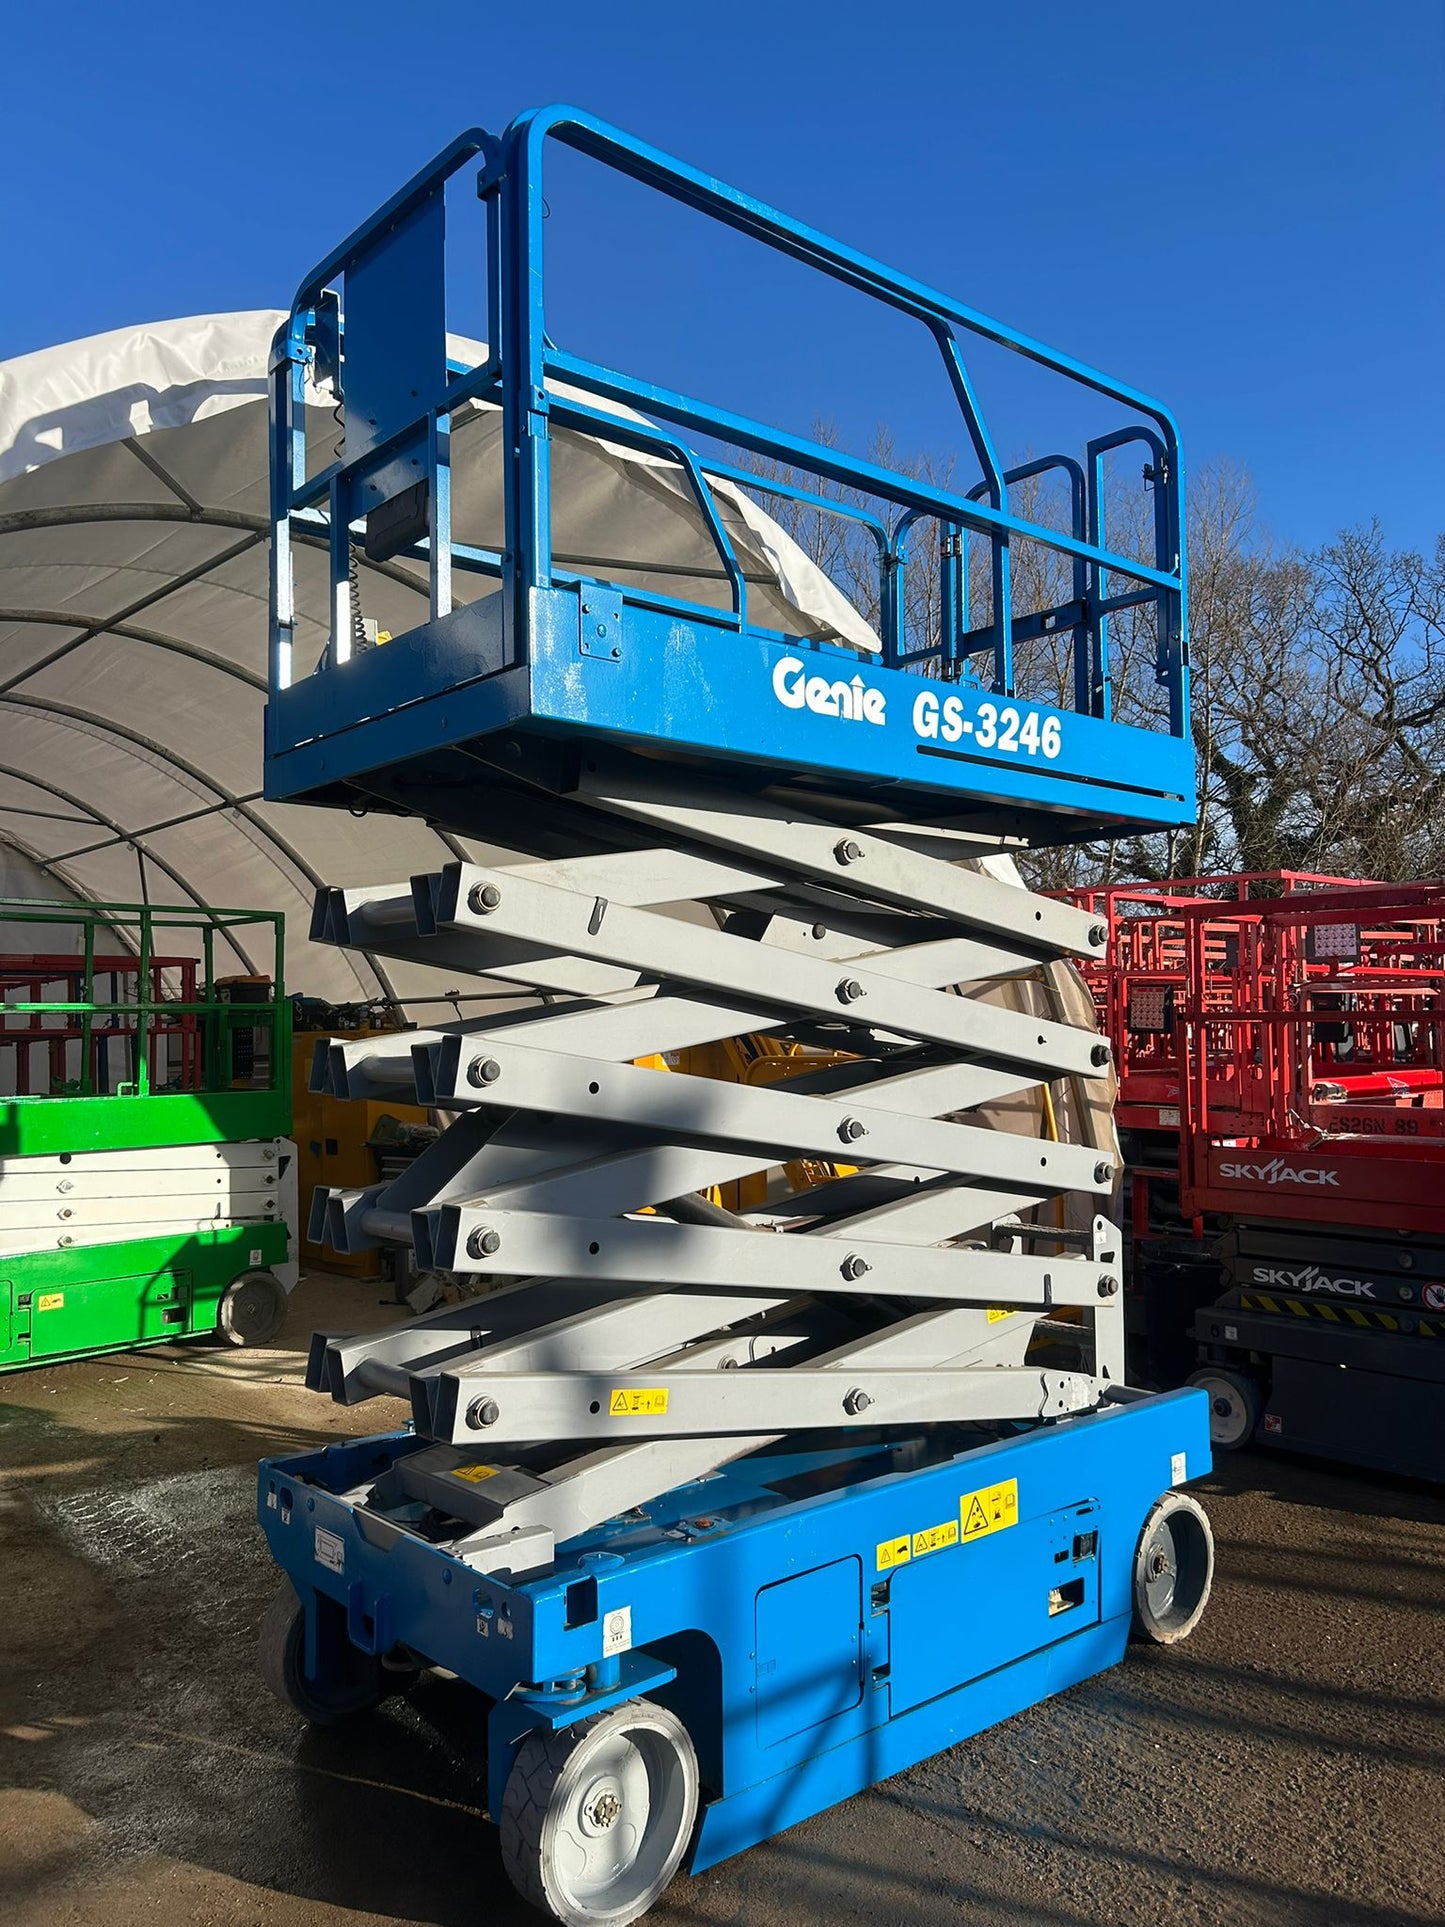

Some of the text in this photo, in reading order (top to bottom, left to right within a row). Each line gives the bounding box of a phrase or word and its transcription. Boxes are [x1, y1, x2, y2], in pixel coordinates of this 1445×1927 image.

[773, 657, 886, 725] Genie
[913, 692, 1061, 758] GS-3246
[1219, 1158, 1340, 1186] SKYJACK
[1252, 1266, 1376, 1298] SKYJACK
